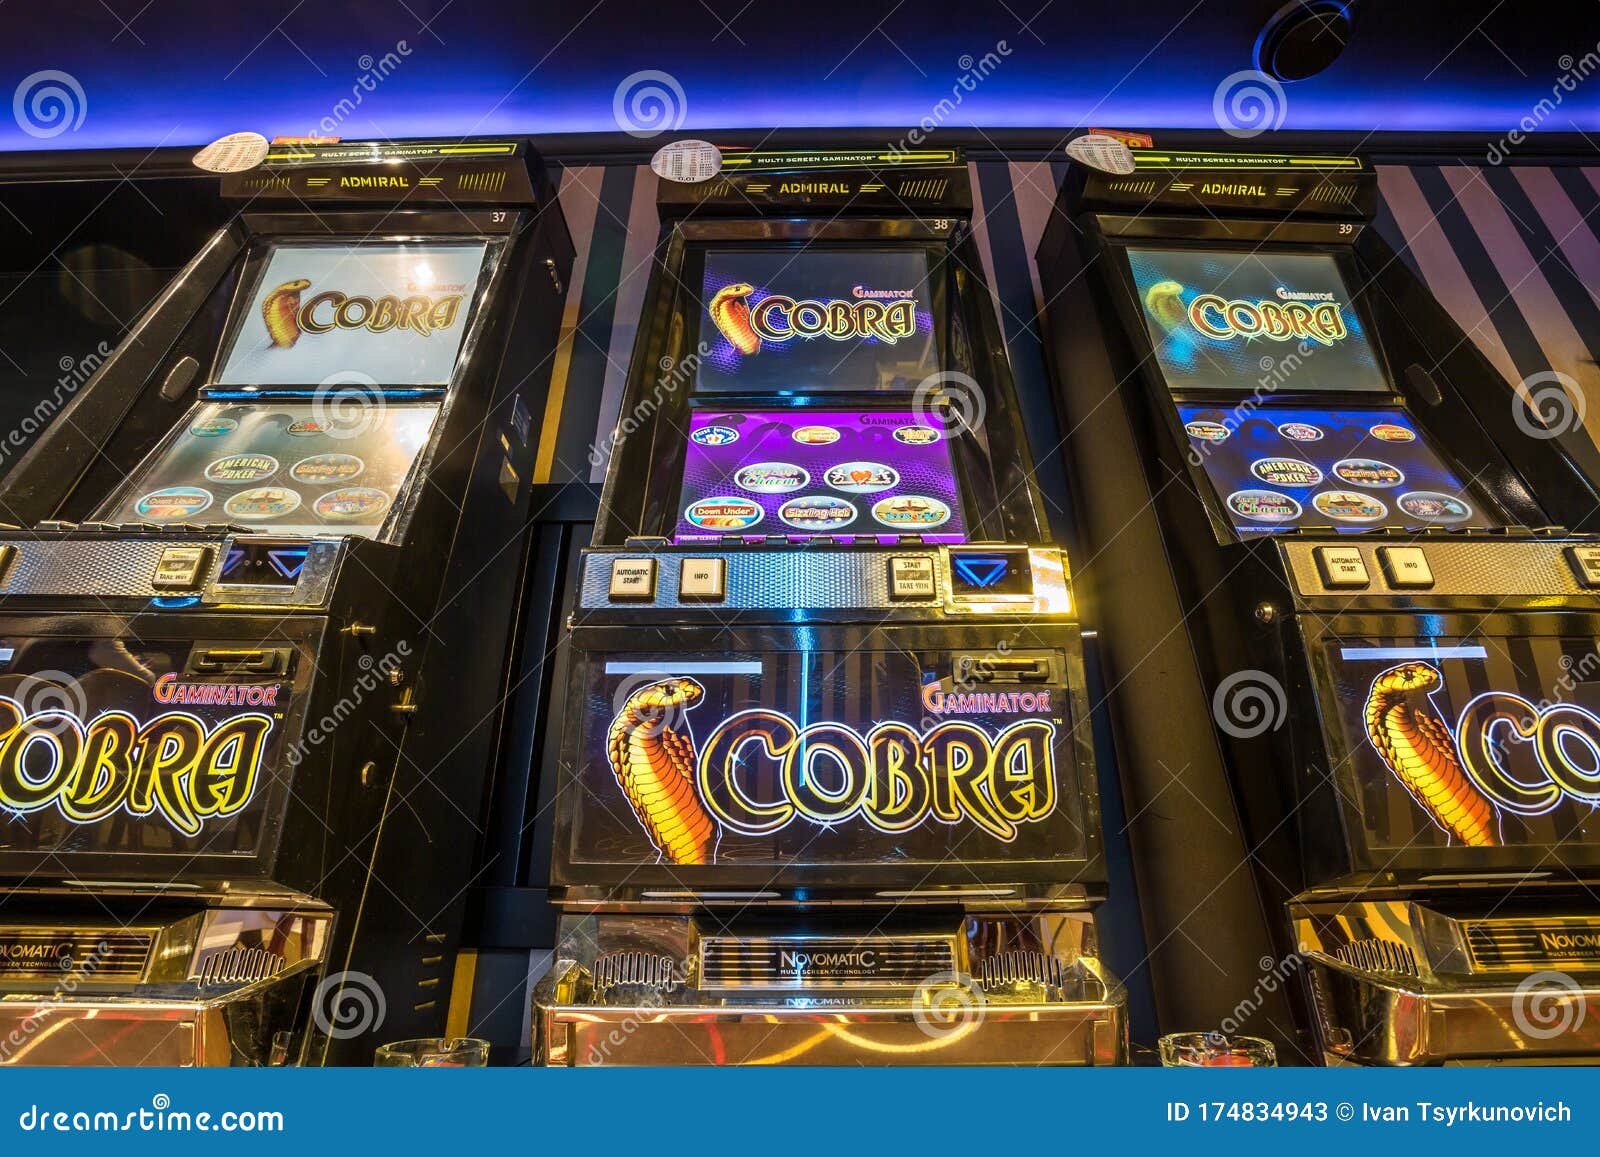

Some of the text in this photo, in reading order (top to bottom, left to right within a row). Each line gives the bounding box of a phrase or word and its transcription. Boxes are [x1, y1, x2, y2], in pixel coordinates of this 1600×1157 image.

[340, 177, 409, 187] ADMIRAL
[779, 183, 849, 193] ADMIRAL
[1201, 183, 1266, 196] ADMIRAL
[491, 212, 506, 223] 37
[933, 219, 948, 230] 38
[1338, 224, 1353, 235] 39
[852, 286, 913, 298] GAMINATOR
[1276, 287, 1335, 300] GAMINATOR
[297, 290, 464, 337] COBRA
[749, 295, 916, 344] COBRA
[1187, 294, 1348, 346] COBRA
[215, 458, 271, 471] AMERICAN
[1259, 461, 1313, 474] AMERICAN
[221, 470, 256, 479] POKER
[1272, 472, 1309, 483] POKER
[723, 507, 751, 515] Under
[1239, 503, 1294, 514] Charm
[153, 672, 280, 707] GAMINATOR
[921, 681, 1051, 714] GAMINATOR
[696, 708, 1057, 843] COBRA
[781, 951, 876, 968] NOVOMATIC
